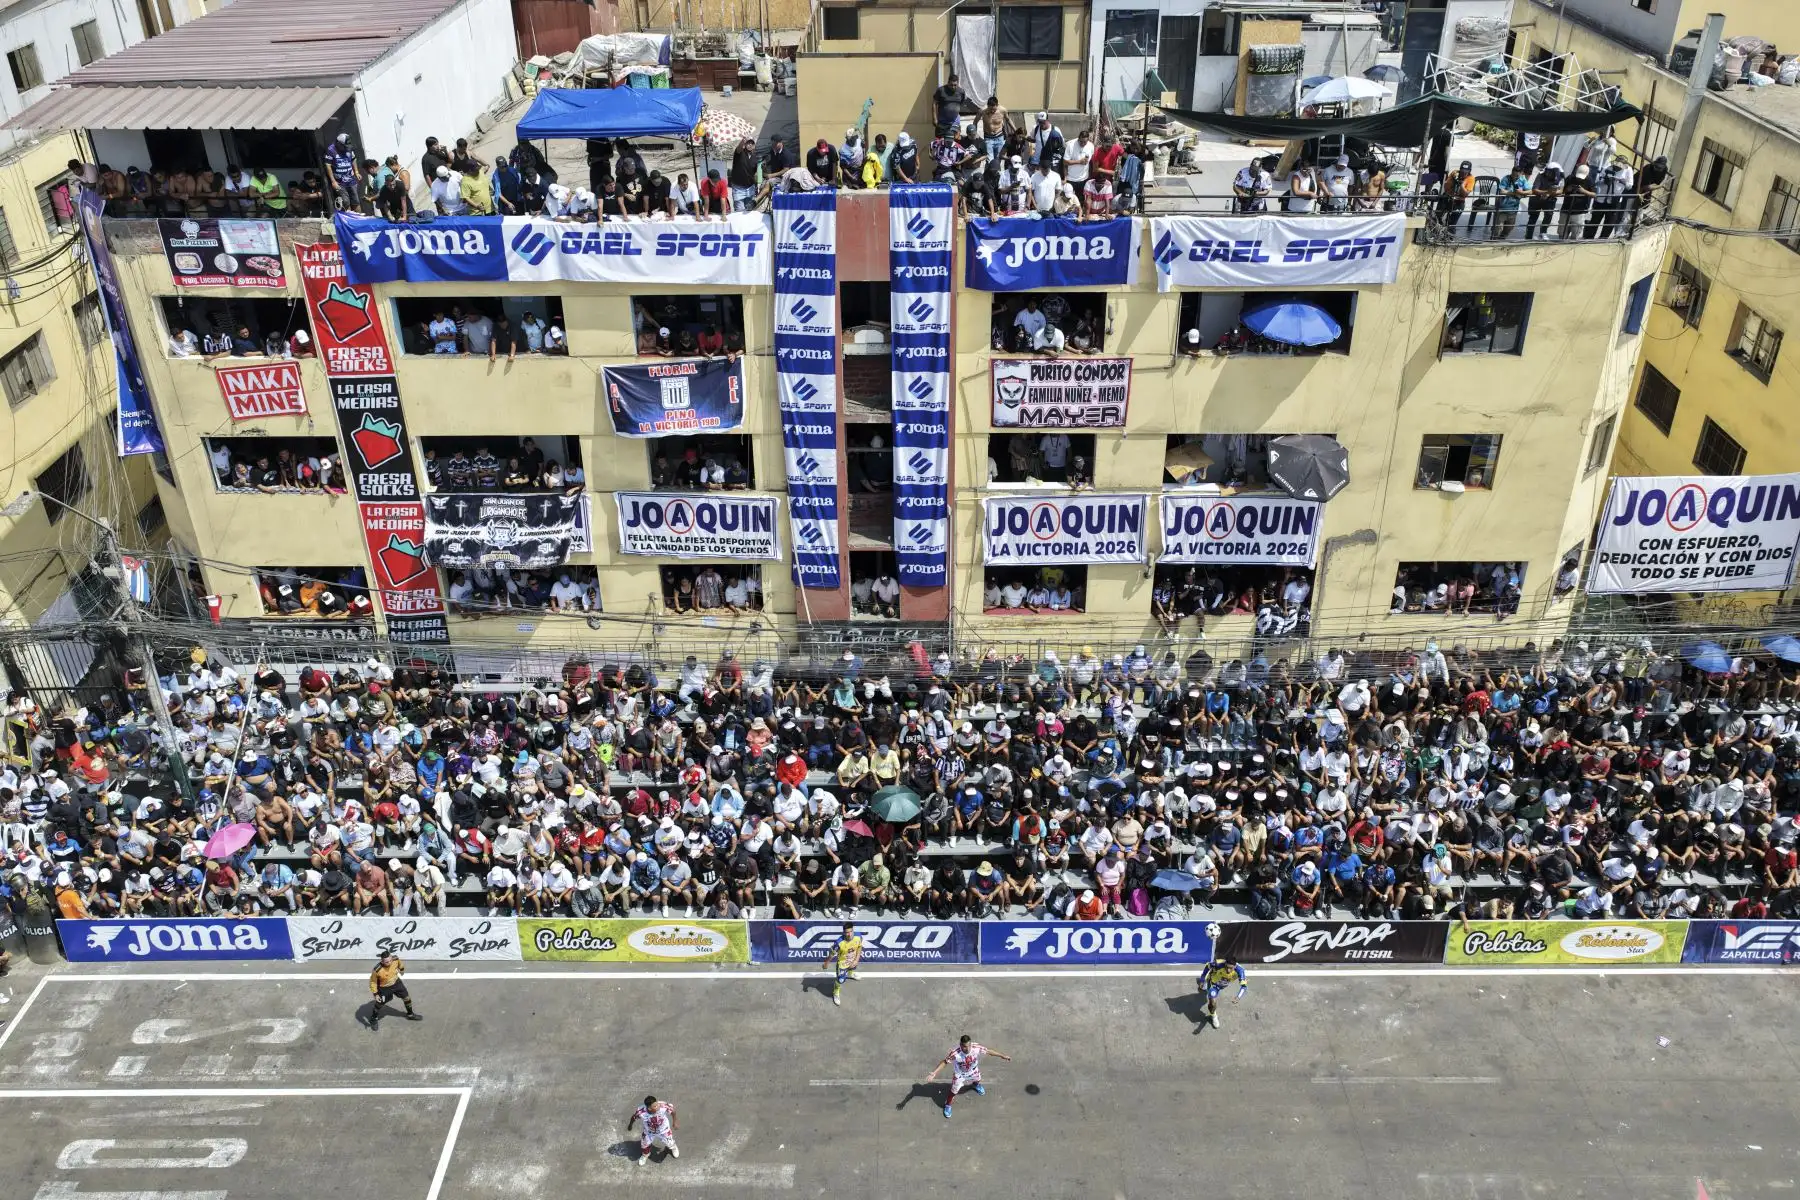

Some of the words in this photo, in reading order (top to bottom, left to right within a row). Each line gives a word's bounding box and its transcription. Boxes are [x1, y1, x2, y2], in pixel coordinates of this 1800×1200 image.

[561, 232, 642, 257] GAEL
[655, 233, 763, 258] SPORT
[1189, 239, 1270, 263] GAEL
[1281, 236, 1396, 262] SPORT
[303, 250, 318, 262] LA
[303, 265, 347, 279] MEDI
[328, 346, 384, 360] FRESA
[330, 359, 388, 372] SOCKS
[648, 363, 698, 377] FLORAL
[1030, 363, 1071, 381] PURITO
[1074, 363, 1126, 381] CONDOR
[225, 368, 298, 393] NAKA
[337, 384, 354, 395] LA
[357, 383, 392, 394] CASA
[1028, 387, 1063, 403] FAMILIA
[1098, 386, 1126, 402] MEMO
[232, 391, 303, 415] MINE
[338, 396, 398, 410] MEDIAS
[665, 409, 696, 420] PINO
[1019, 406, 1121, 424] MAYER
[639, 423, 652, 432] LA
[655, 418, 699, 431] VICTORIA
[359, 473, 412, 485] FRESA
[360, 484, 415, 496] SOCKS
[367, 507, 382, 516] LA
[385, 507, 418, 516] CASA
[627, 500, 771, 534] JOAQUIN
[366, 519, 424, 530] MEDIAS
[992, 505, 1139, 538] JOAQUIN
[1167, 505, 1316, 538] JOAQUIN
[628, 534, 667, 543] FELICITA
[670, 535, 682, 544] LA
[685, 536, 716, 545] FIESTA
[719, 537, 771, 546] DEPORTIVA
[1639, 538, 1672, 550] CON
[1678, 535, 1762, 550] ESFUERZO,
[632, 542, 638, 550] Y
[656, 543, 691, 552] UNIDAD
[694, 544, 706, 552] DE
[709, 544, 726, 553] LOS
[729, 546, 769, 554] VECINOS
[992, 543, 1011, 557] LA
[1015, 542, 1090, 556] VICTORIA
[1095, 540, 1137, 555] 2026
[1164, 542, 1183, 555] LA
[1188, 542, 1261, 555] VICTORIA
[1266, 542, 1308, 556] 2026
[1600, 550, 1699, 565] DEDICACIÓN
[1705, 552, 1715, 563] Y
[1719, 551, 1752, 562] CON
[1755, 546, 1793, 561] DIOS
[1631, 568, 1675, 579] TODO
[1679, 567, 1699, 578] SE
[1703, 564, 1755, 578] PUEDE
[386, 588, 436, 600] FRESA
[387, 600, 438, 611] SOCKS
[391, 620, 406, 629] LA
[390, 629, 447, 642] MEDIAS
[535, 927, 617, 953] Pelotas
[1463, 930, 1548, 956] Pelotas
[887, 950, 942, 958] DEPORTIVA
[1344, 950, 1394, 959] FUTSAL
[1720, 951, 1782, 959] ZAPATILLAS
